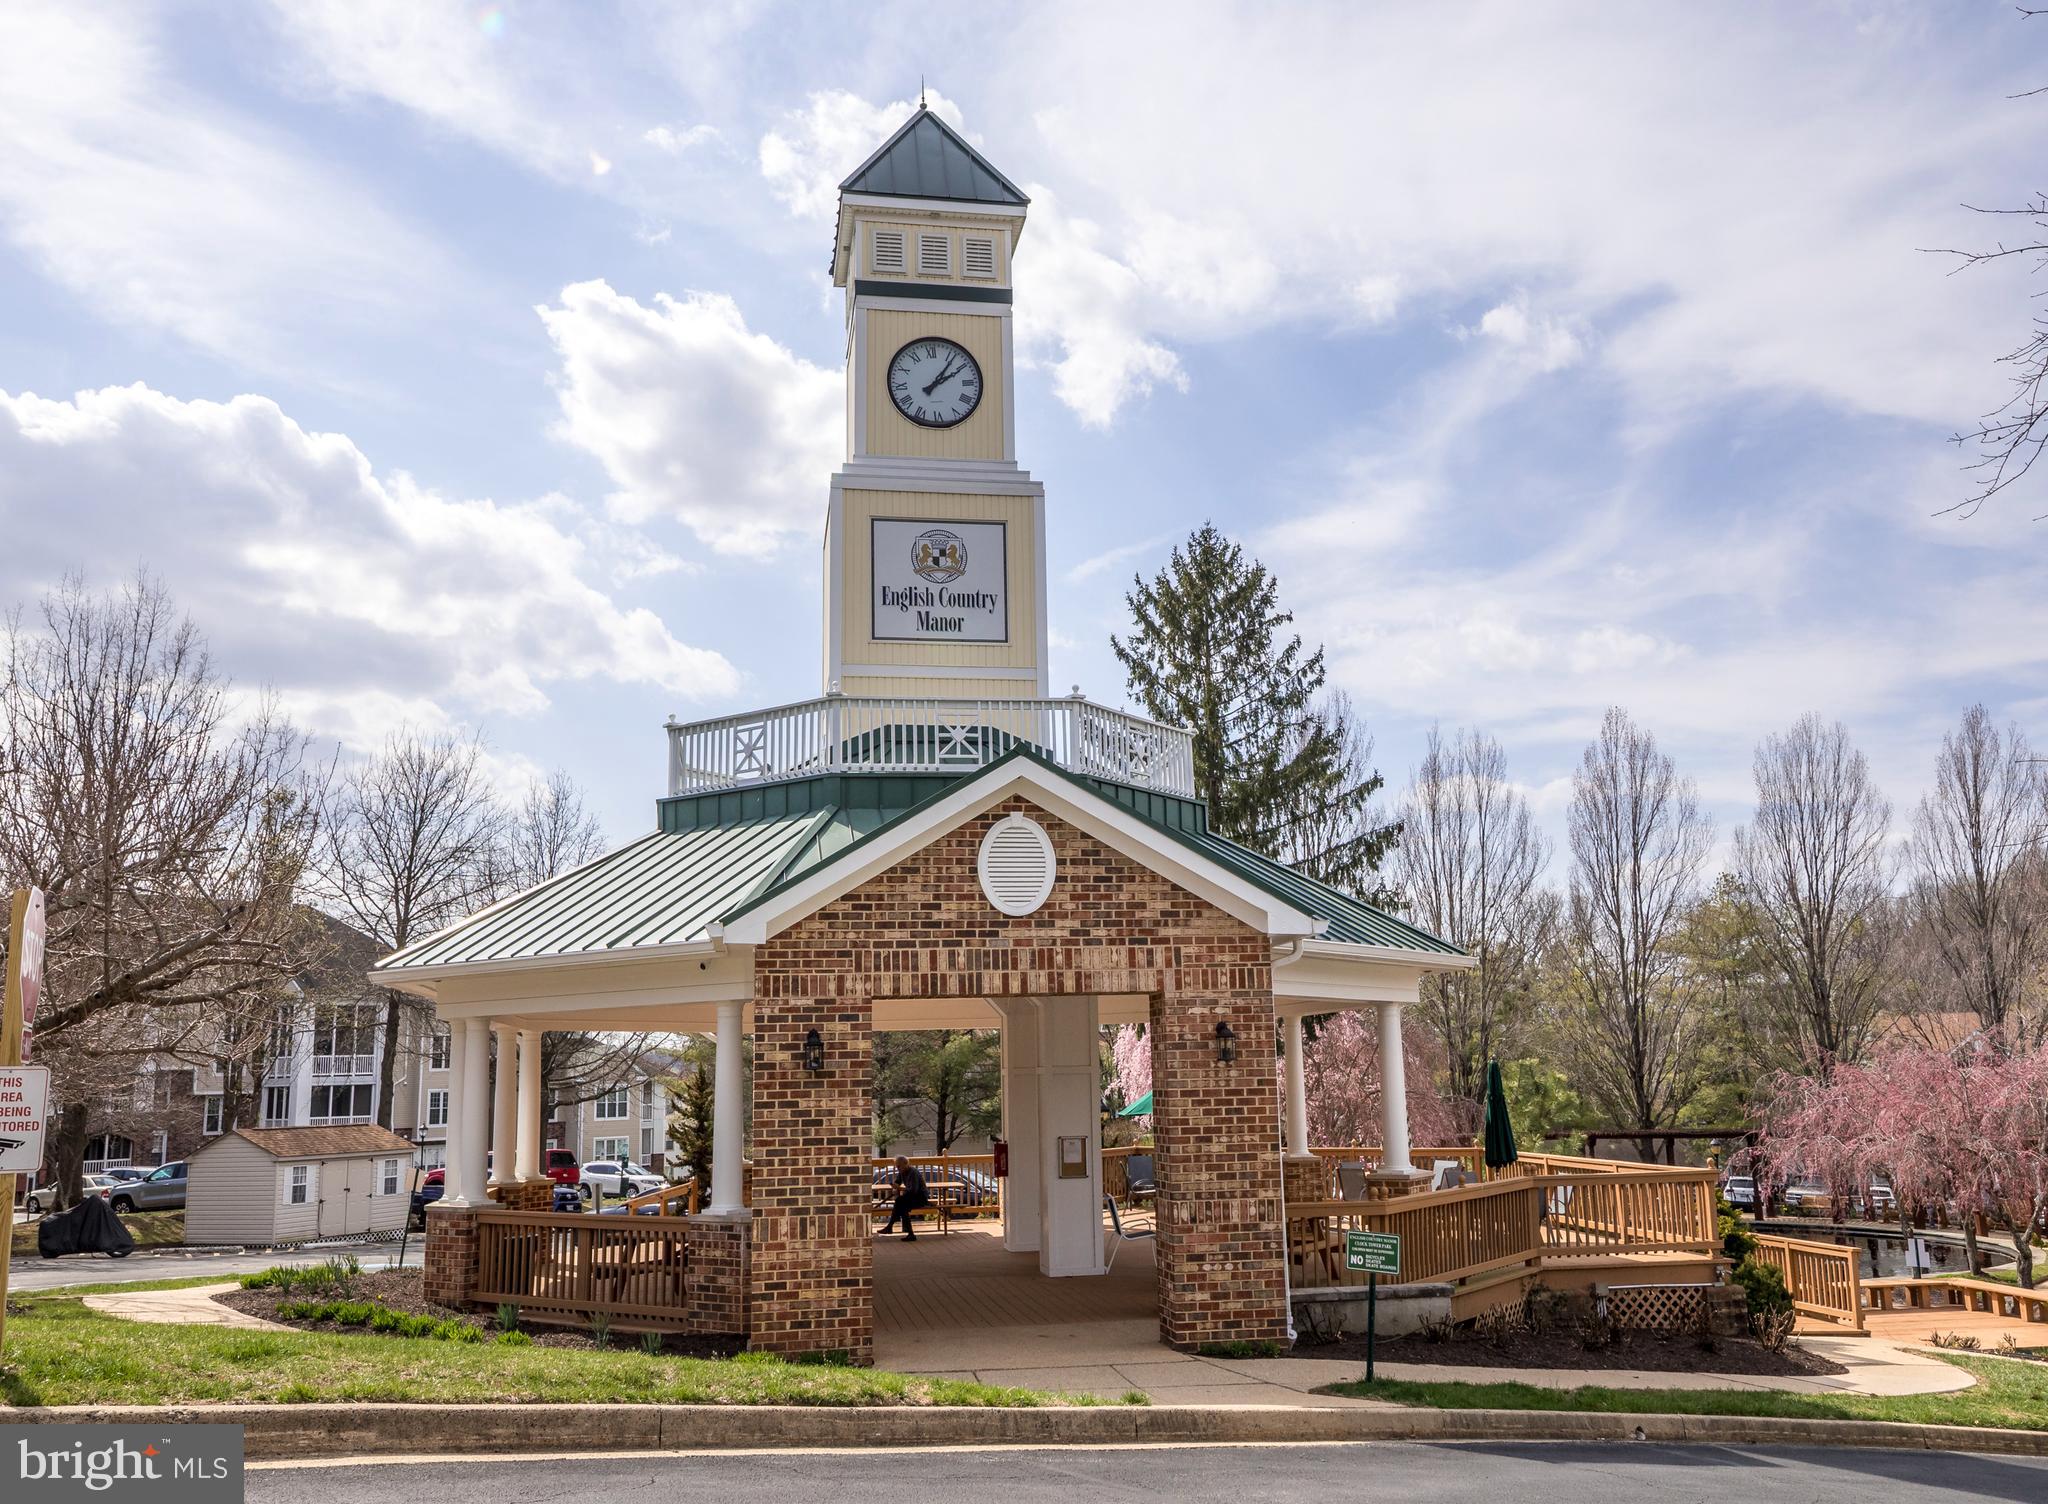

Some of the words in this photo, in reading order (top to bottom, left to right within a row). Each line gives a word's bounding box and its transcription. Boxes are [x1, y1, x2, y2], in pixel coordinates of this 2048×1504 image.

[881, 585, 935, 613] English
[939, 586, 998, 614] Country
[916, 610, 965, 632] Manor
[23, 929, 43, 983] STOP
[0, 1092, 23, 1102] REA
[0, 1121, 40, 1132] TORED
[1350, 1254, 1364, 1265] NO
